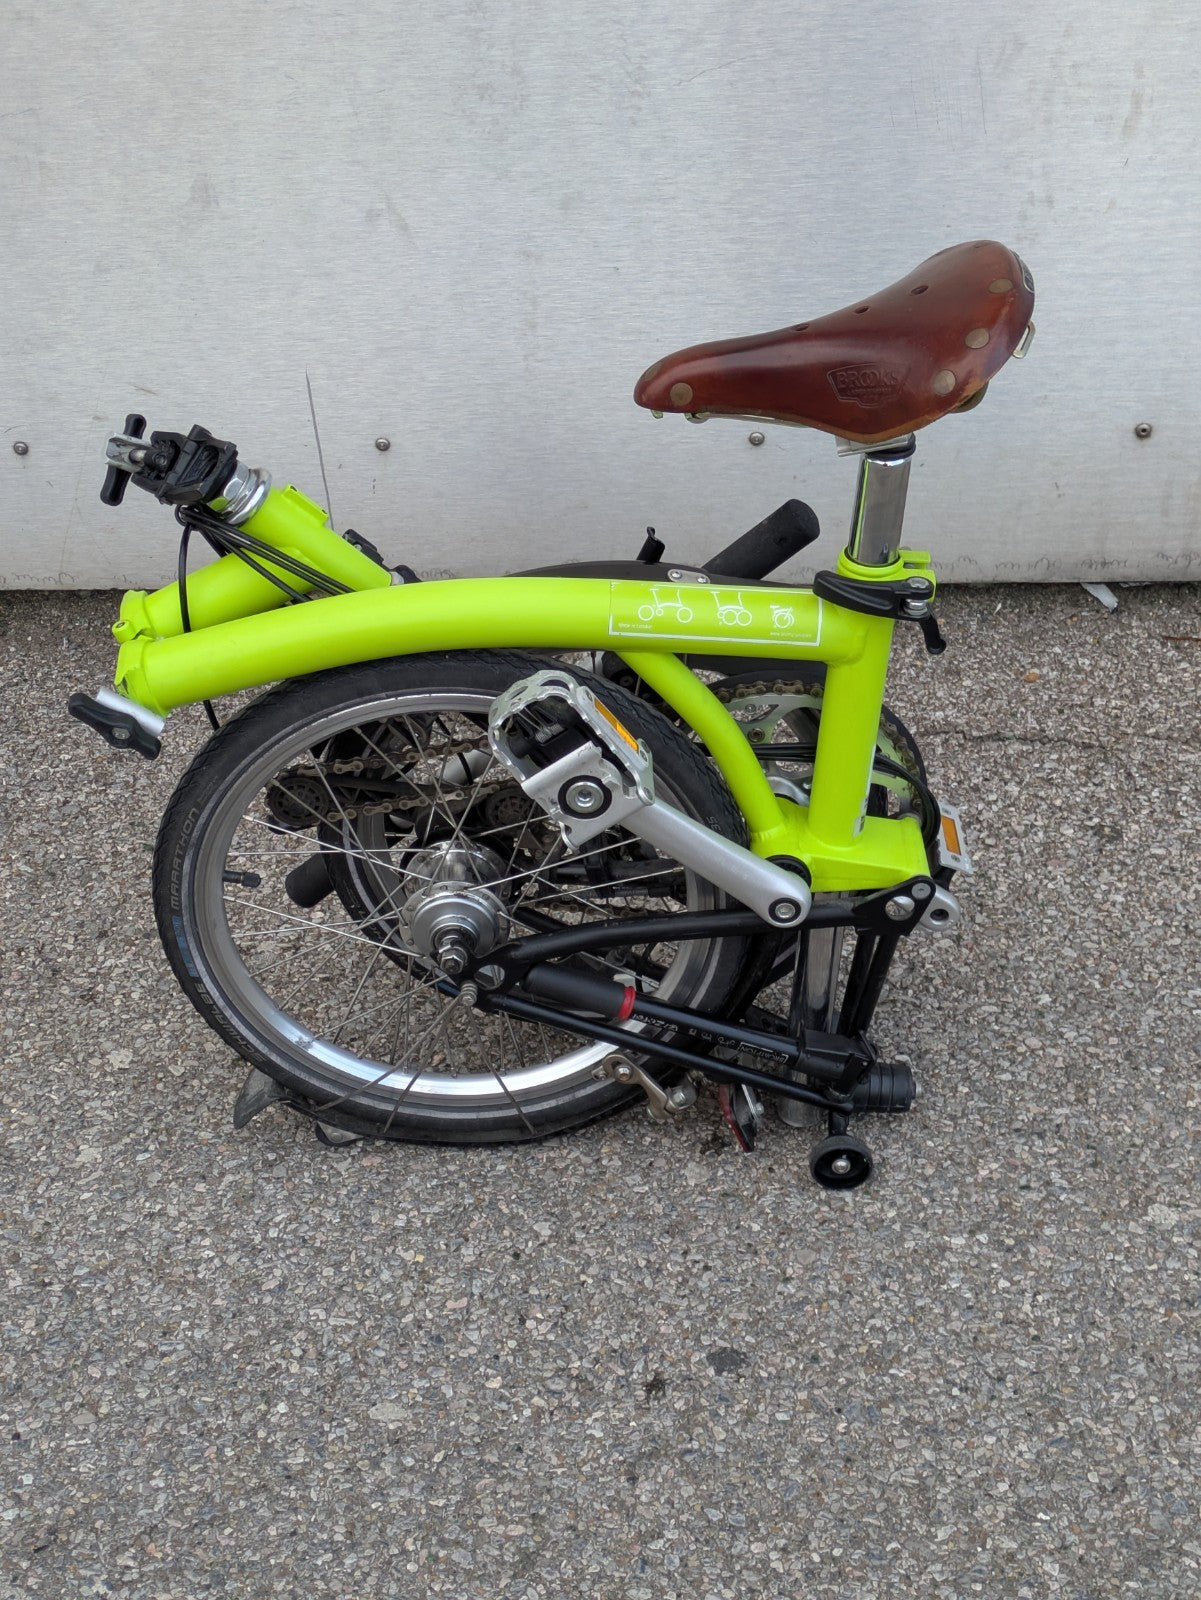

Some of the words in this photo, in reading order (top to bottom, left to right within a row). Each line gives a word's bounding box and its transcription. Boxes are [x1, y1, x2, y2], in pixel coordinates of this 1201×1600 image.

[836, 368, 899, 387] BROOKS
[170, 807, 199, 910] MARATHON
[195, 982, 267, 1063] SCHWALBE
